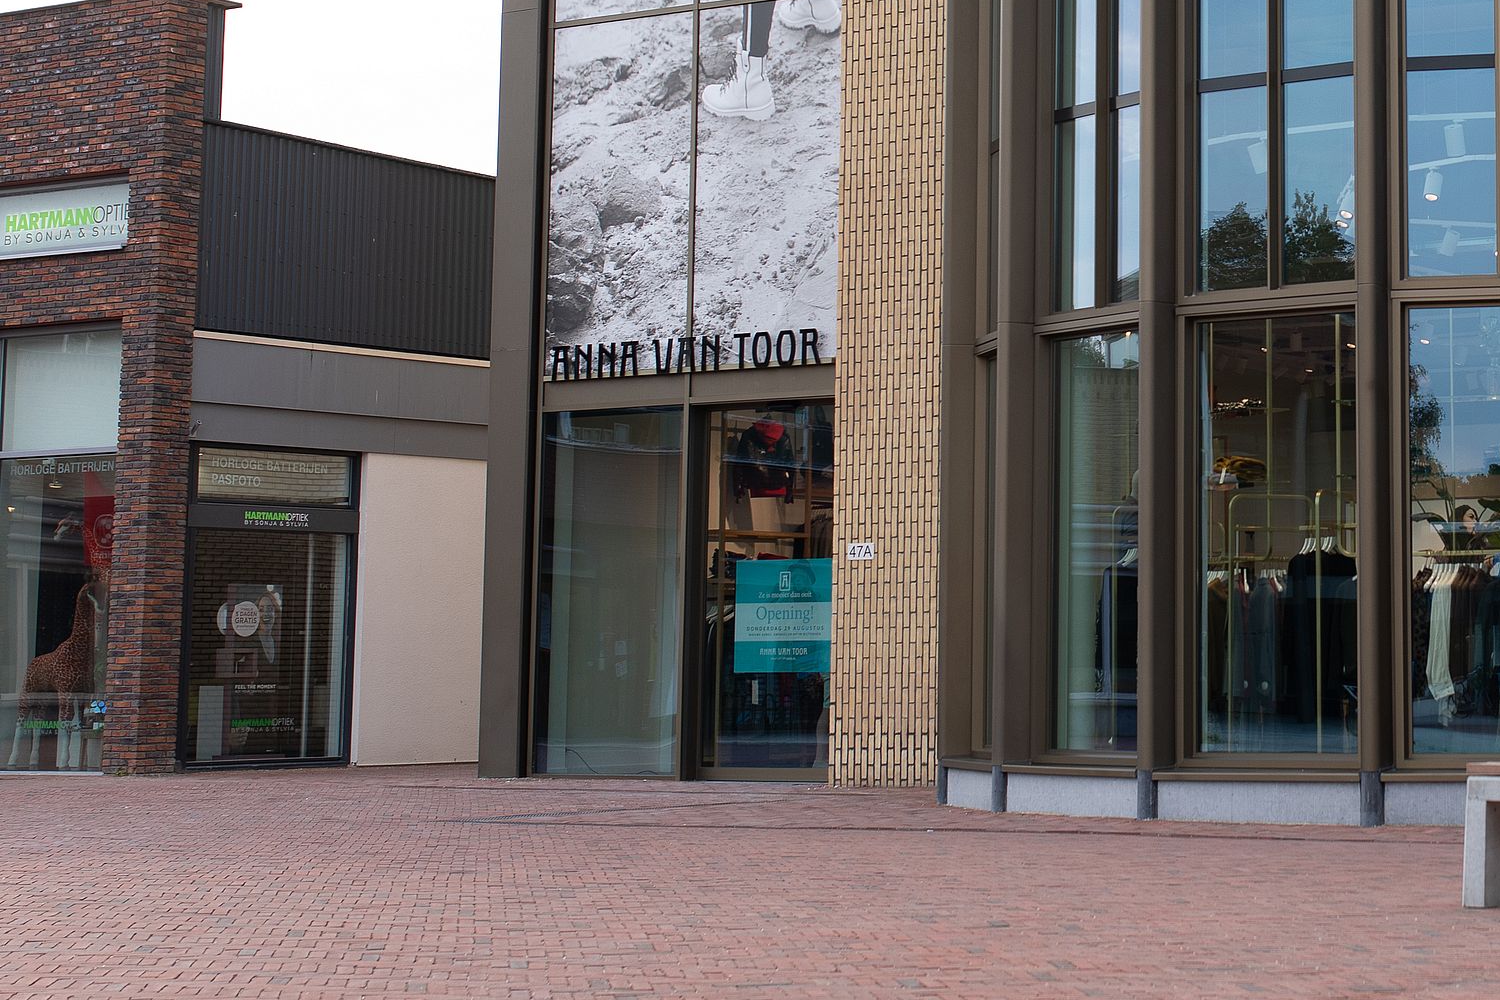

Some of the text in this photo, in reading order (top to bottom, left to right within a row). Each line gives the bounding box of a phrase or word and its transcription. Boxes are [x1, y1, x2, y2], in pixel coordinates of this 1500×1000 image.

[4, 235, 20, 246] BY
[25, 229, 72, 243] SONJA
[78, 227, 85, 238] &
[551, 327, 821, 381] ANNA VAN TOOR
[10, 461, 114, 475] HORLOGE BATTERIJEN
[211, 457, 328, 474] HORLOGE BATTERIJEN
[211, 473, 261, 487] PASFOTO
[849, 545, 872, 558] 47A
[756, 605, 814, 624] Opening!
[760, 648, 777, 656] ANNA
[792, 647, 808, 655] TOOR
